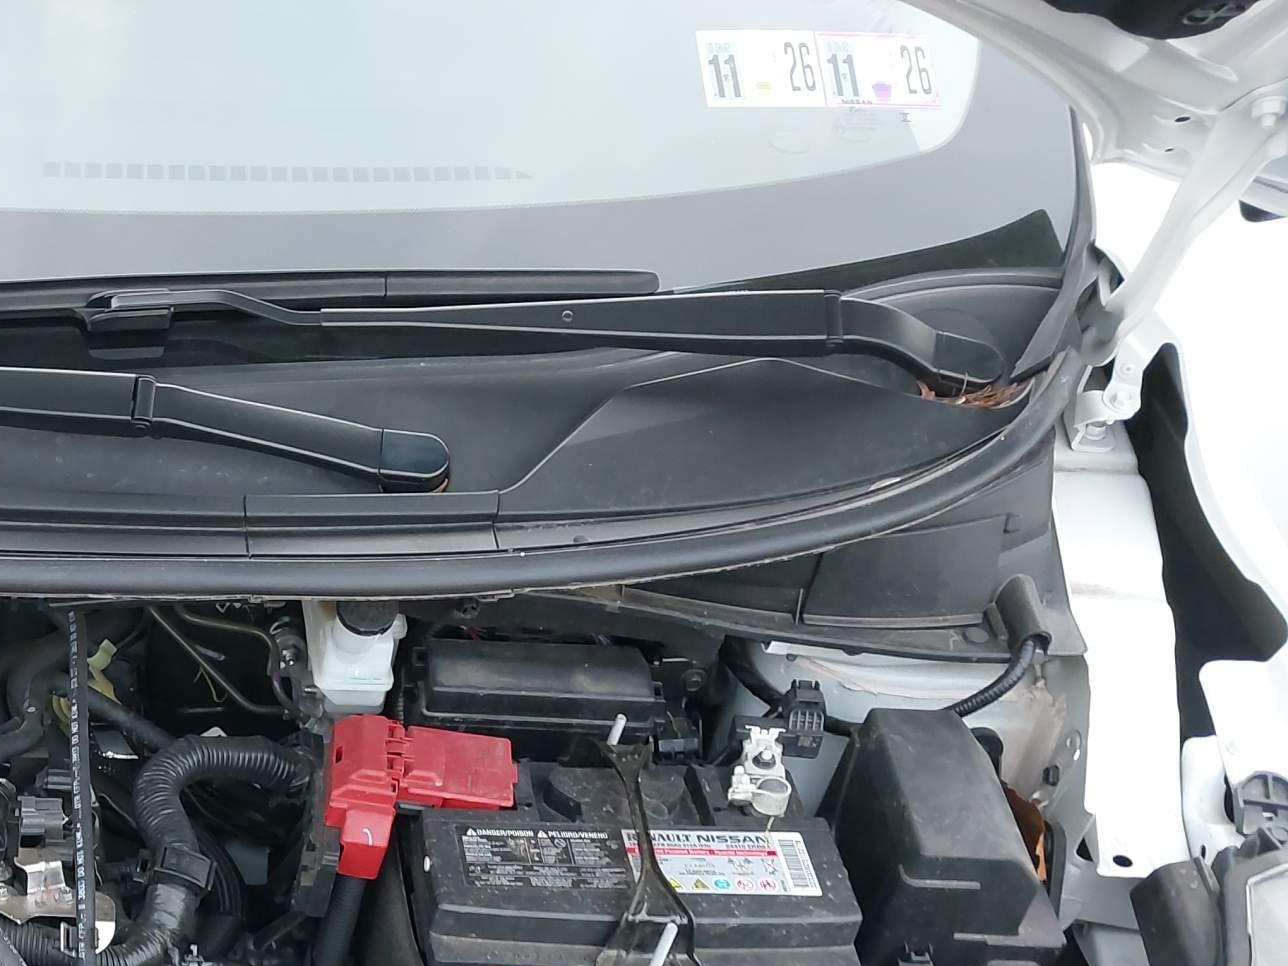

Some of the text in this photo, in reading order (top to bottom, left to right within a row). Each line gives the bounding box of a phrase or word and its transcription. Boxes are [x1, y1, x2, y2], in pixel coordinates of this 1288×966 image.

[708, 42, 816, 98] 11 26
[827, 45, 932, 97] 11 26
[626, 833, 770, 844] RNAULT NISSAN
